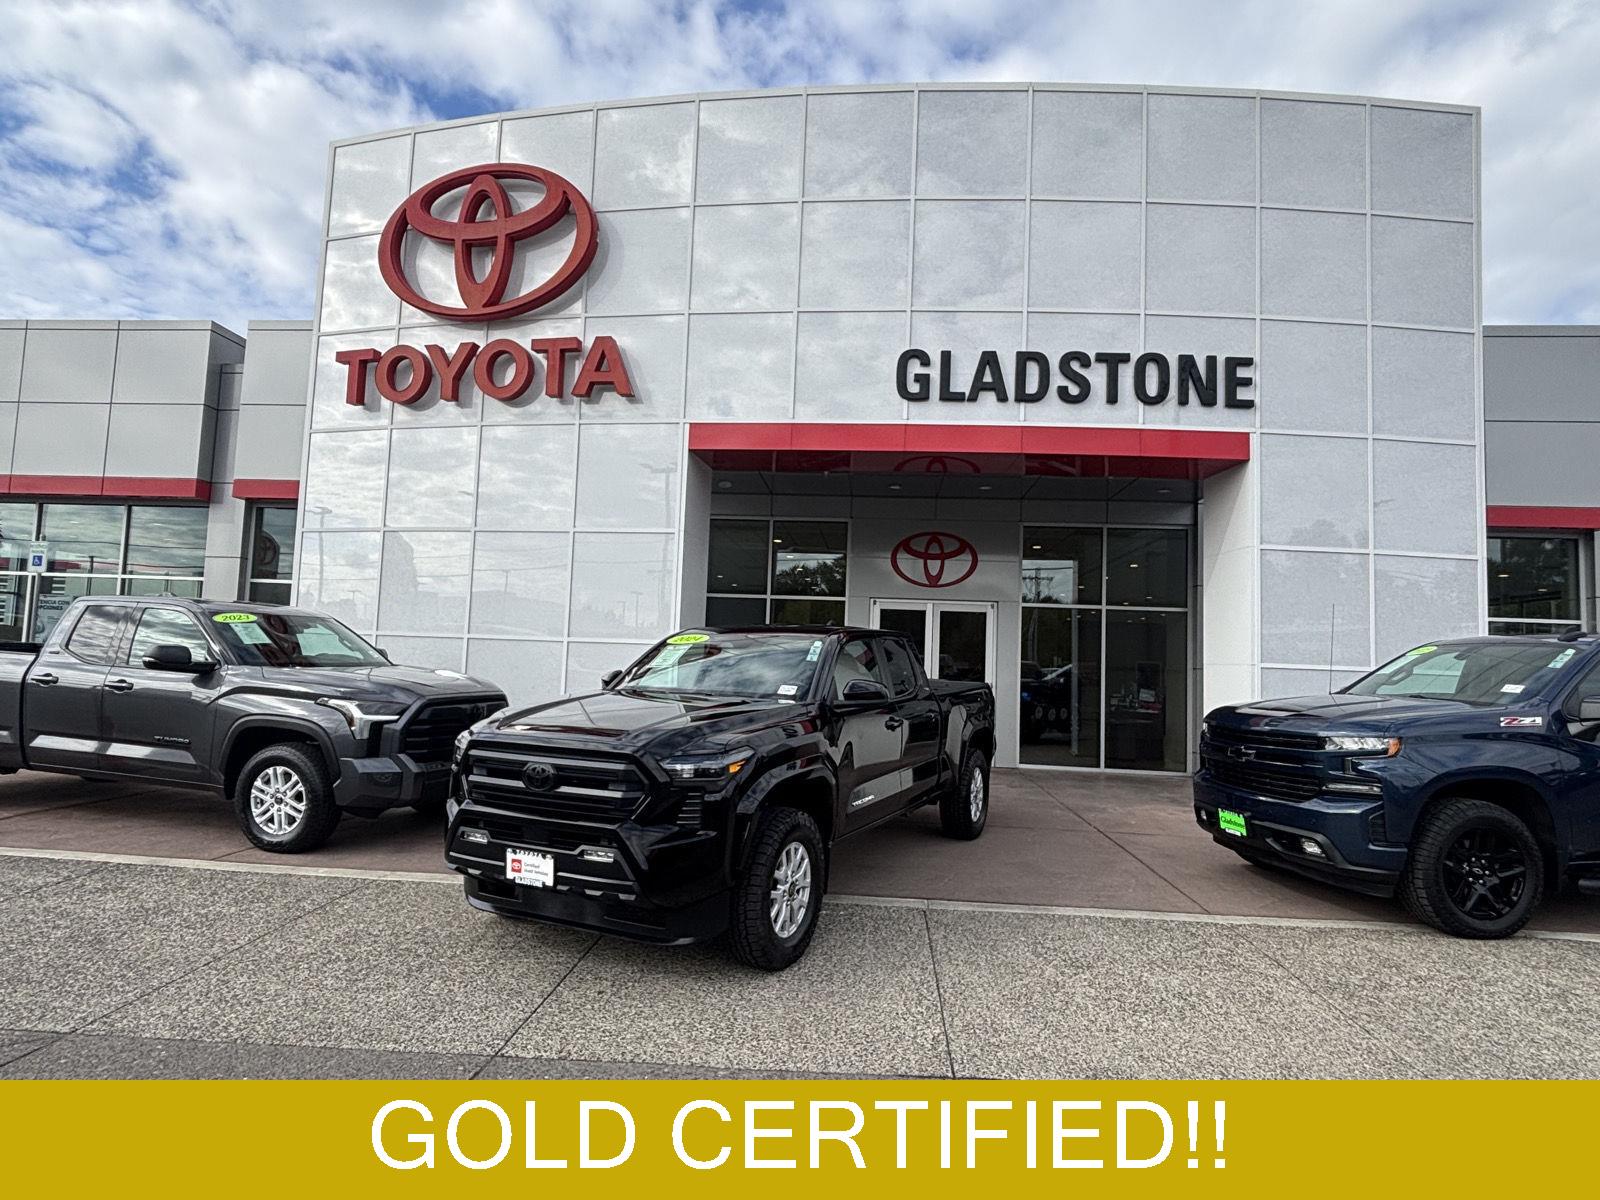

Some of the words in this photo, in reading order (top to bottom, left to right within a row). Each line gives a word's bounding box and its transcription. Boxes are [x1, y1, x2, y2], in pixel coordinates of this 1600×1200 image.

[336, 336, 635, 406] TOYOTA
[896, 349, 1255, 409] GLADSTONE
[221, 613, 250, 622] 2023
